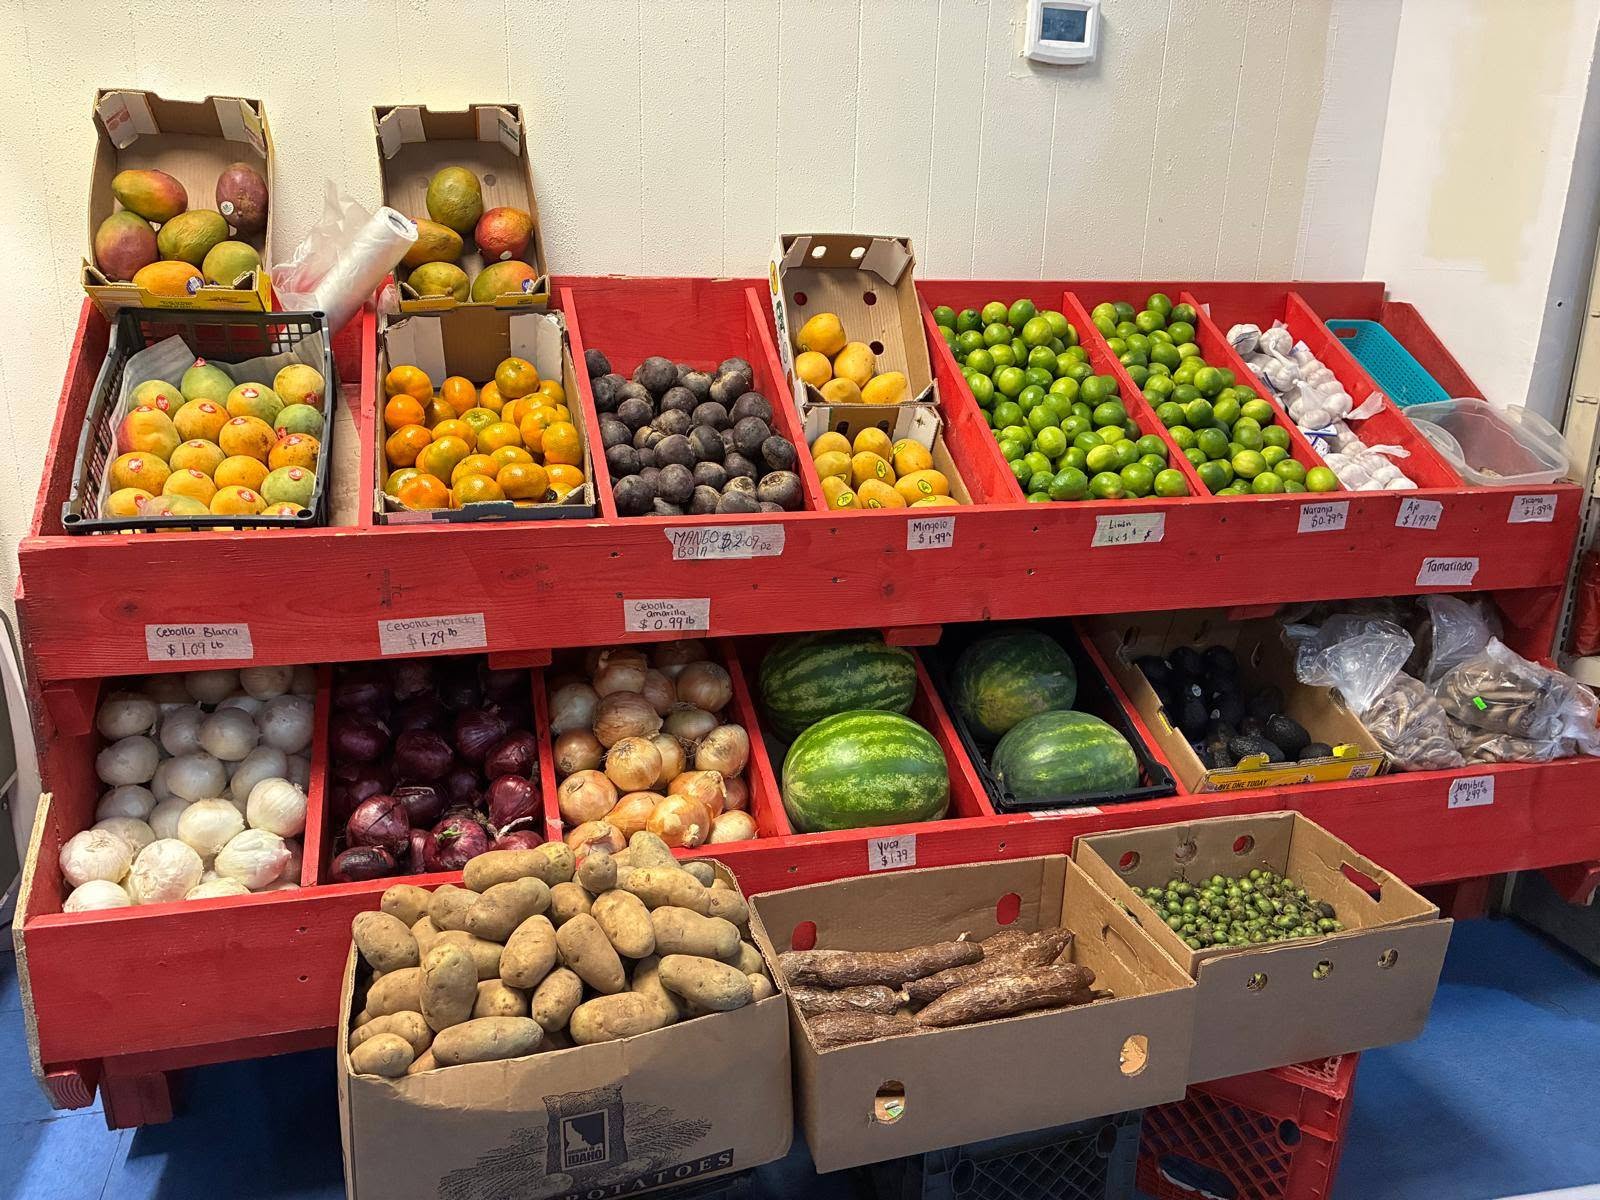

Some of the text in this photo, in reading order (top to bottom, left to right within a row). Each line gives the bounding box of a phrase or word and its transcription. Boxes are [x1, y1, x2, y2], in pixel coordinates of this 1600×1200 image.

[673, 530, 719, 545] MANGO
[1426, 559, 1473, 573] Tamarindo
[634, 601, 674, 612] Cebolla
[646, 609, 686, 618] amarilla
[156, 626, 239, 638] Cebolla Blanca
[1246, 779, 1268, 788] TODAY
[567, 1149, 604, 1165] IDAHO
[565, 1152, 732, 1200] POTATOES
